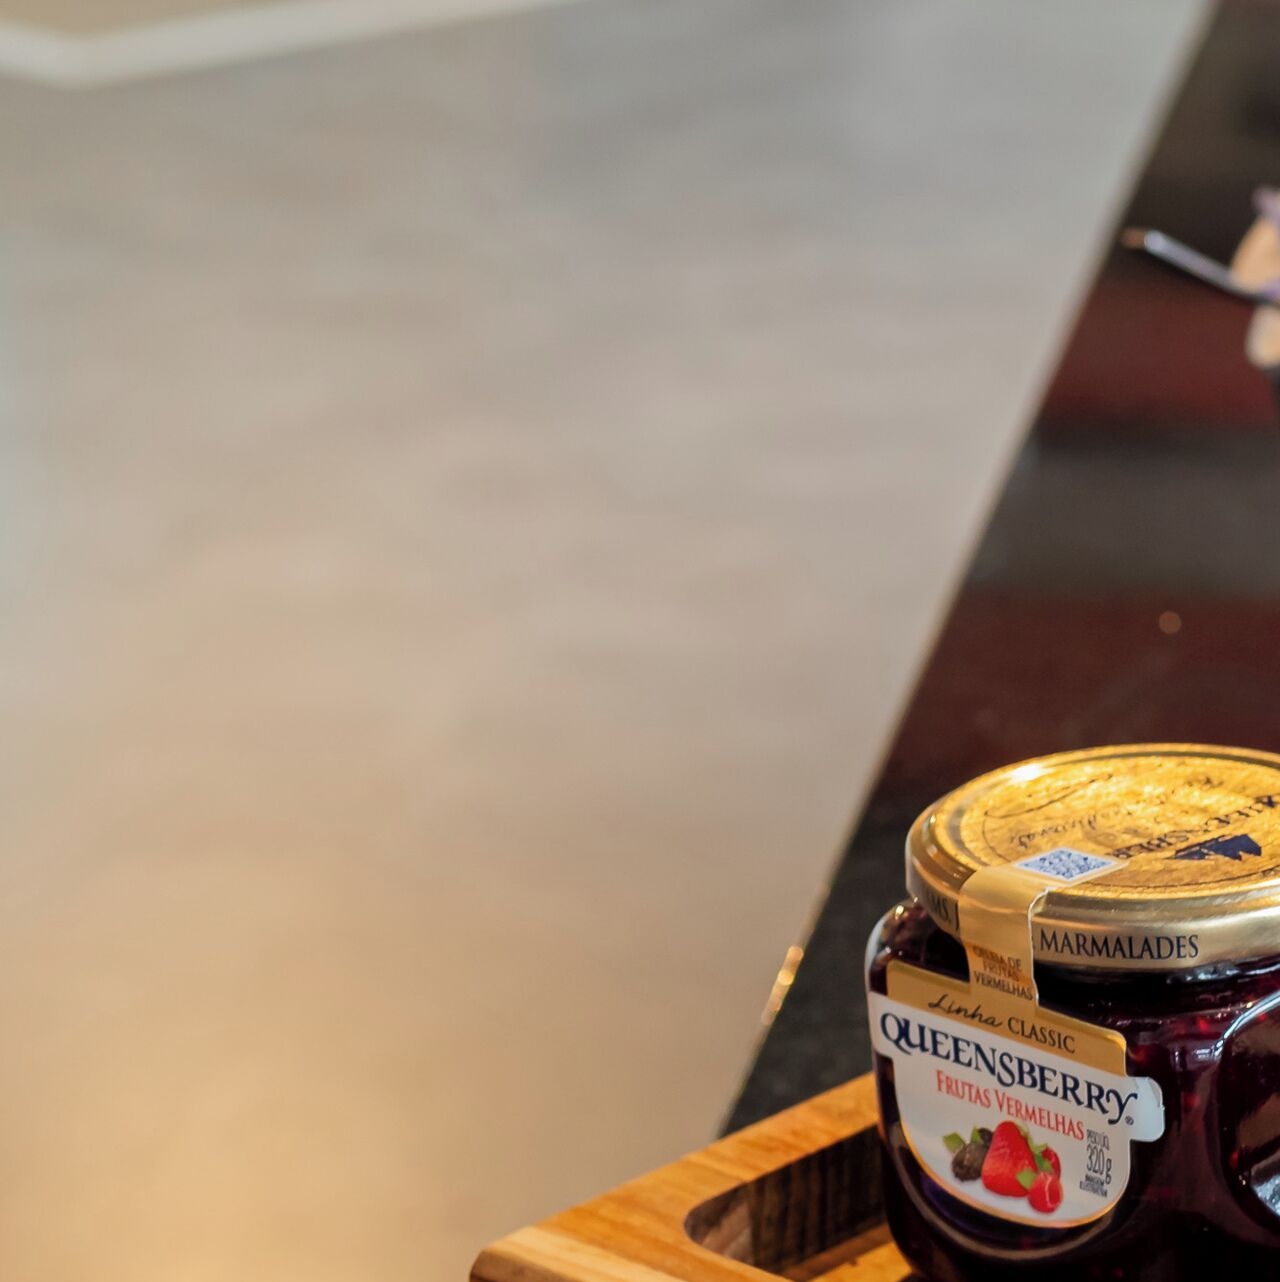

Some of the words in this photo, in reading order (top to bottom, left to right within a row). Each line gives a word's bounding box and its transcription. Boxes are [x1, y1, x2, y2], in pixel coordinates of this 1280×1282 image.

[1040, 927, 1200, 960] MARMALADES
[973, 970, 1034, 1001] VERMELHAS
[928, 993, 1003, 1028] Linha
[1007, 1016, 1076, 1054] CLASSIC
[880, 1012, 1138, 1126] QUEENSBERRY
[935, 1069, 992, 1109] FRUTAS
[995, 1089, 1085, 1141] VERMELHAS
